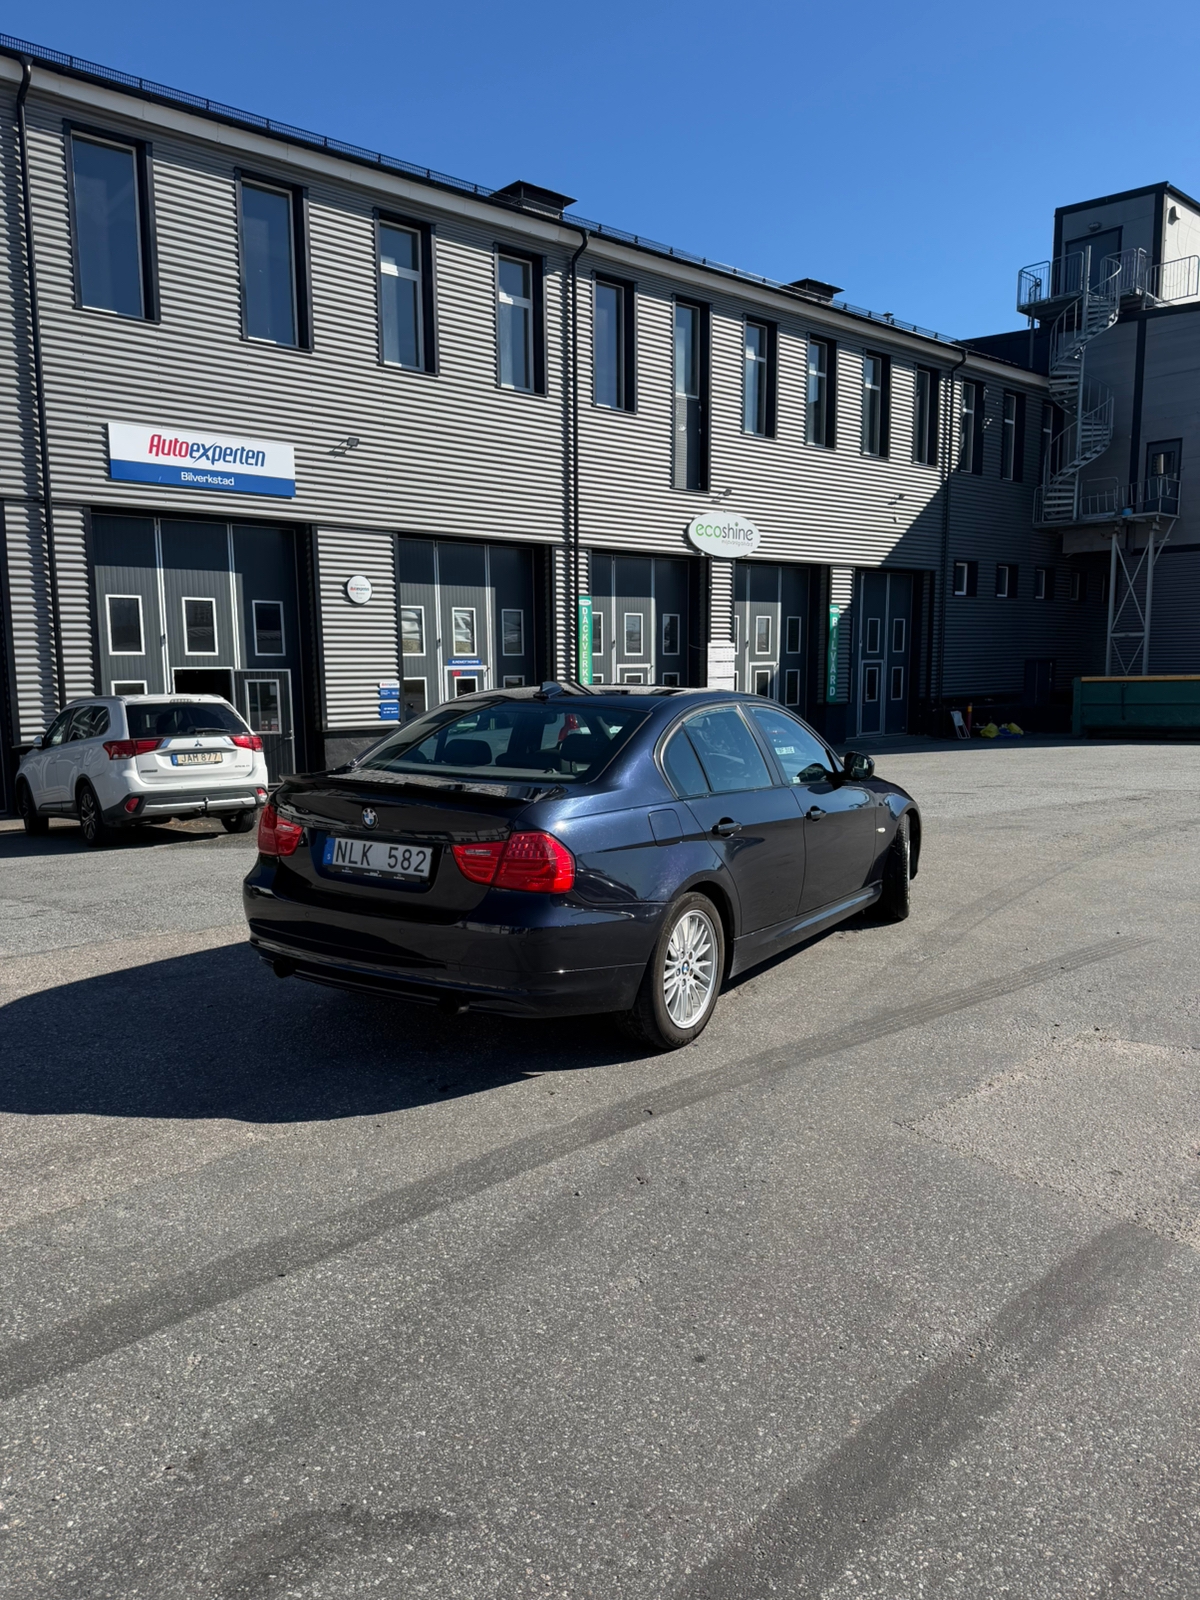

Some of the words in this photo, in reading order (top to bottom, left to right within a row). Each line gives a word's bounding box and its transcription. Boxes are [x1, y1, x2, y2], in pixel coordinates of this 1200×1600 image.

[148, 434, 266, 467] Autoexperten
[181, 471, 235, 486] Bilverkstad
[695, 521, 754, 541] ecoshine
[335, 840, 373, 867] NLK
[387, 846, 427, 873] 582
